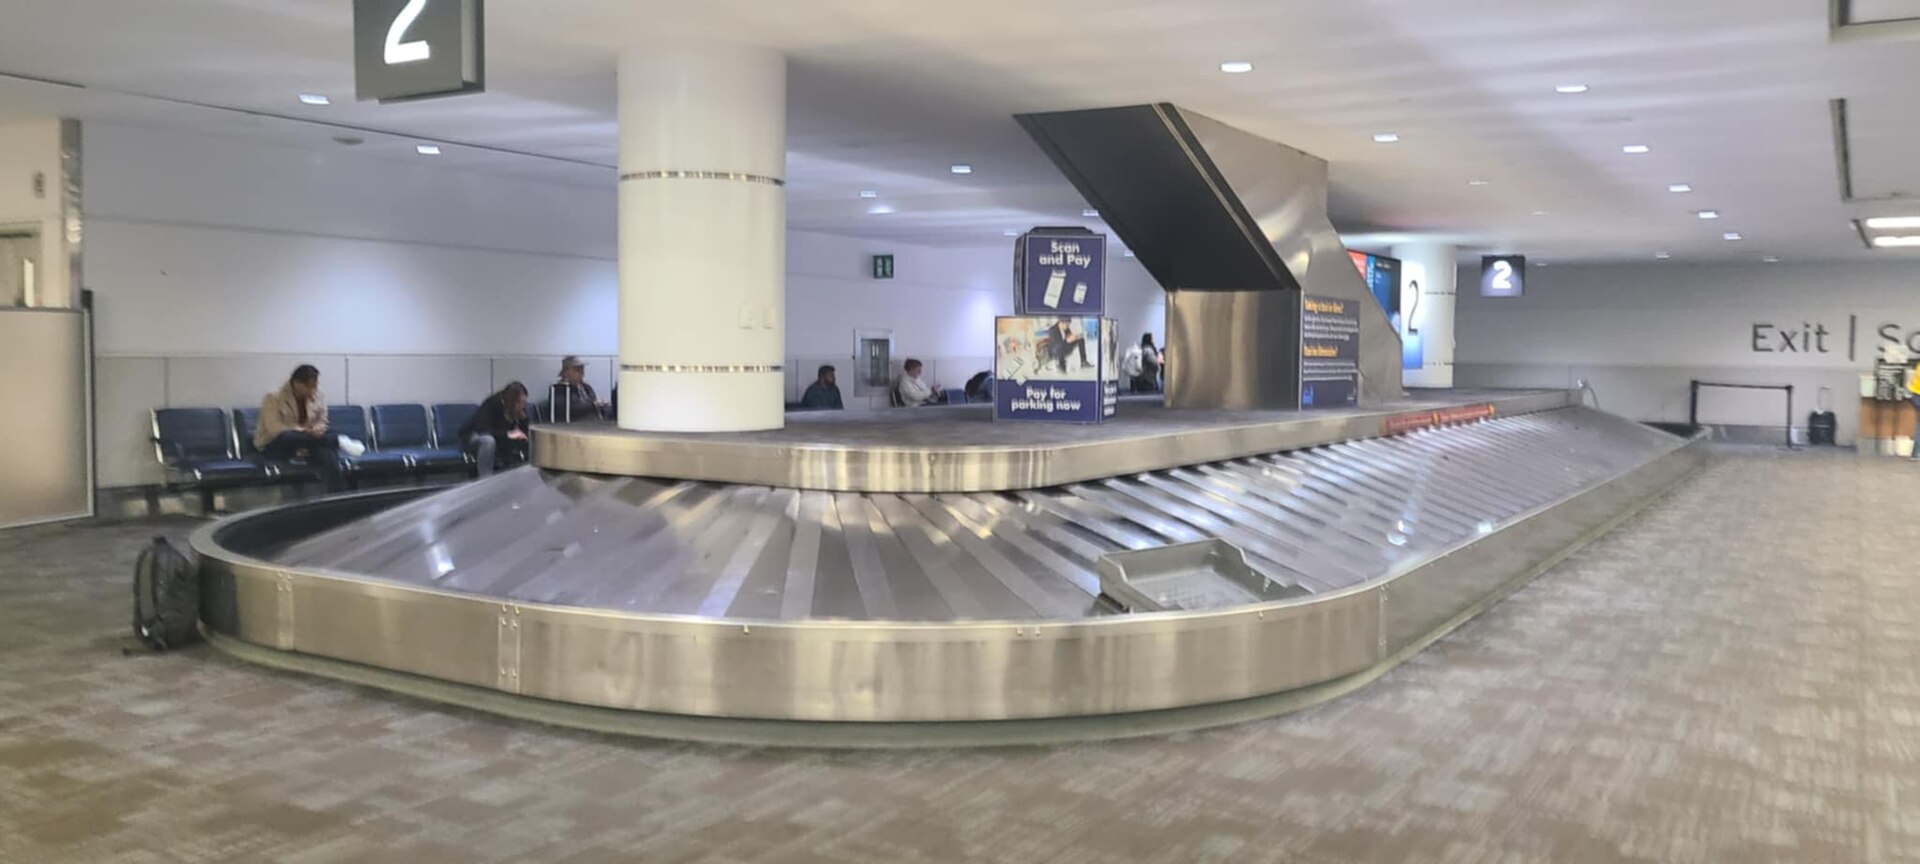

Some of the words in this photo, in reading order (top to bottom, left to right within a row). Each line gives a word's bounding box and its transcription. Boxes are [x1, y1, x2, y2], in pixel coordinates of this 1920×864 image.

[384, 0, 430, 64] 2
[1050, 241, 1080, 253] Scan
[1039, 254, 1063, 265] and
[1067, 255, 1091, 268] Pay
[1492, 260, 1511, 289] 2
[1408, 280, 1419, 335] 2
[1752, 323, 1829, 353] Exit
[1026, 387, 1047, 401] Pay
[1049, 386, 1066, 399] for
[1011, 399, 1053, 412] parking
[1056, 400, 1080, 410] now
